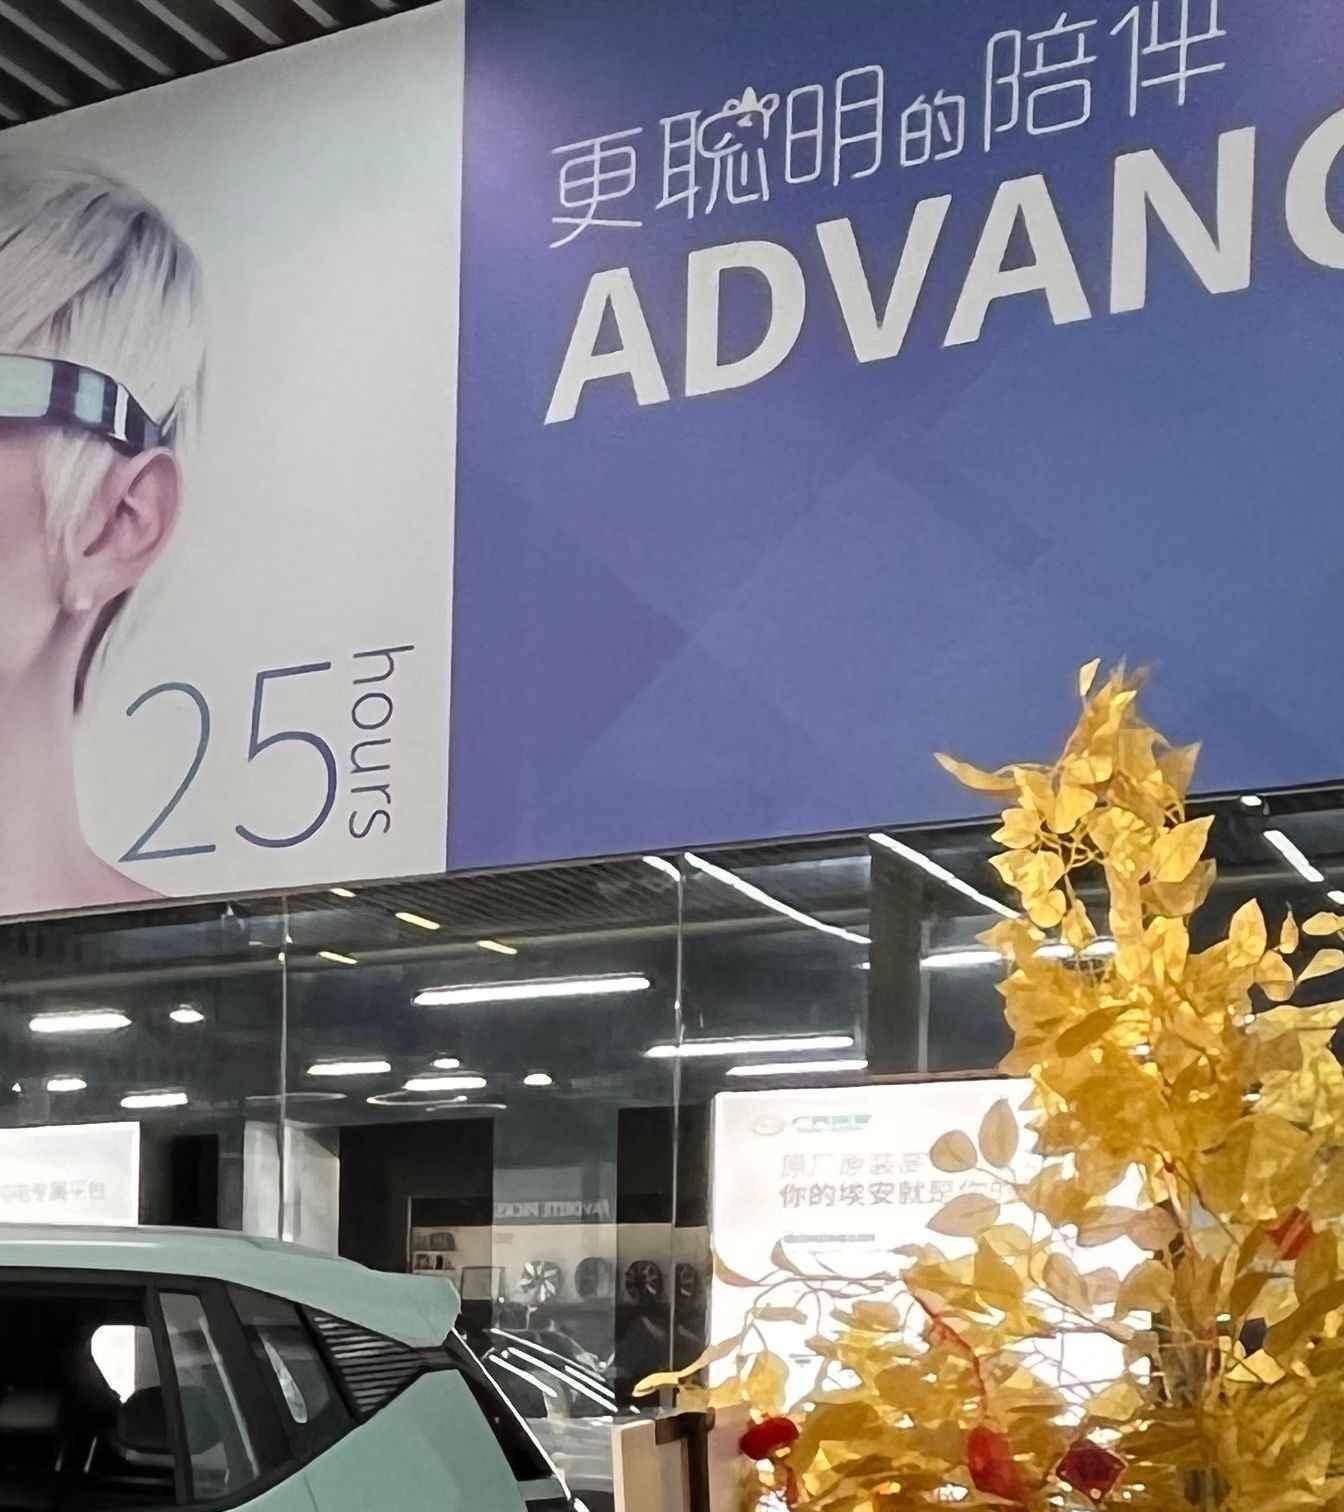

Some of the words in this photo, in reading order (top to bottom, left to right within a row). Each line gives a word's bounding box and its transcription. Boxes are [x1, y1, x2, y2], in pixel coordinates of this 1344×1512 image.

[549, 0, 1227, 248] 更聪明的陪伴
[117, 660, 338, 863] 25
[348, 644, 415, 839] hours
